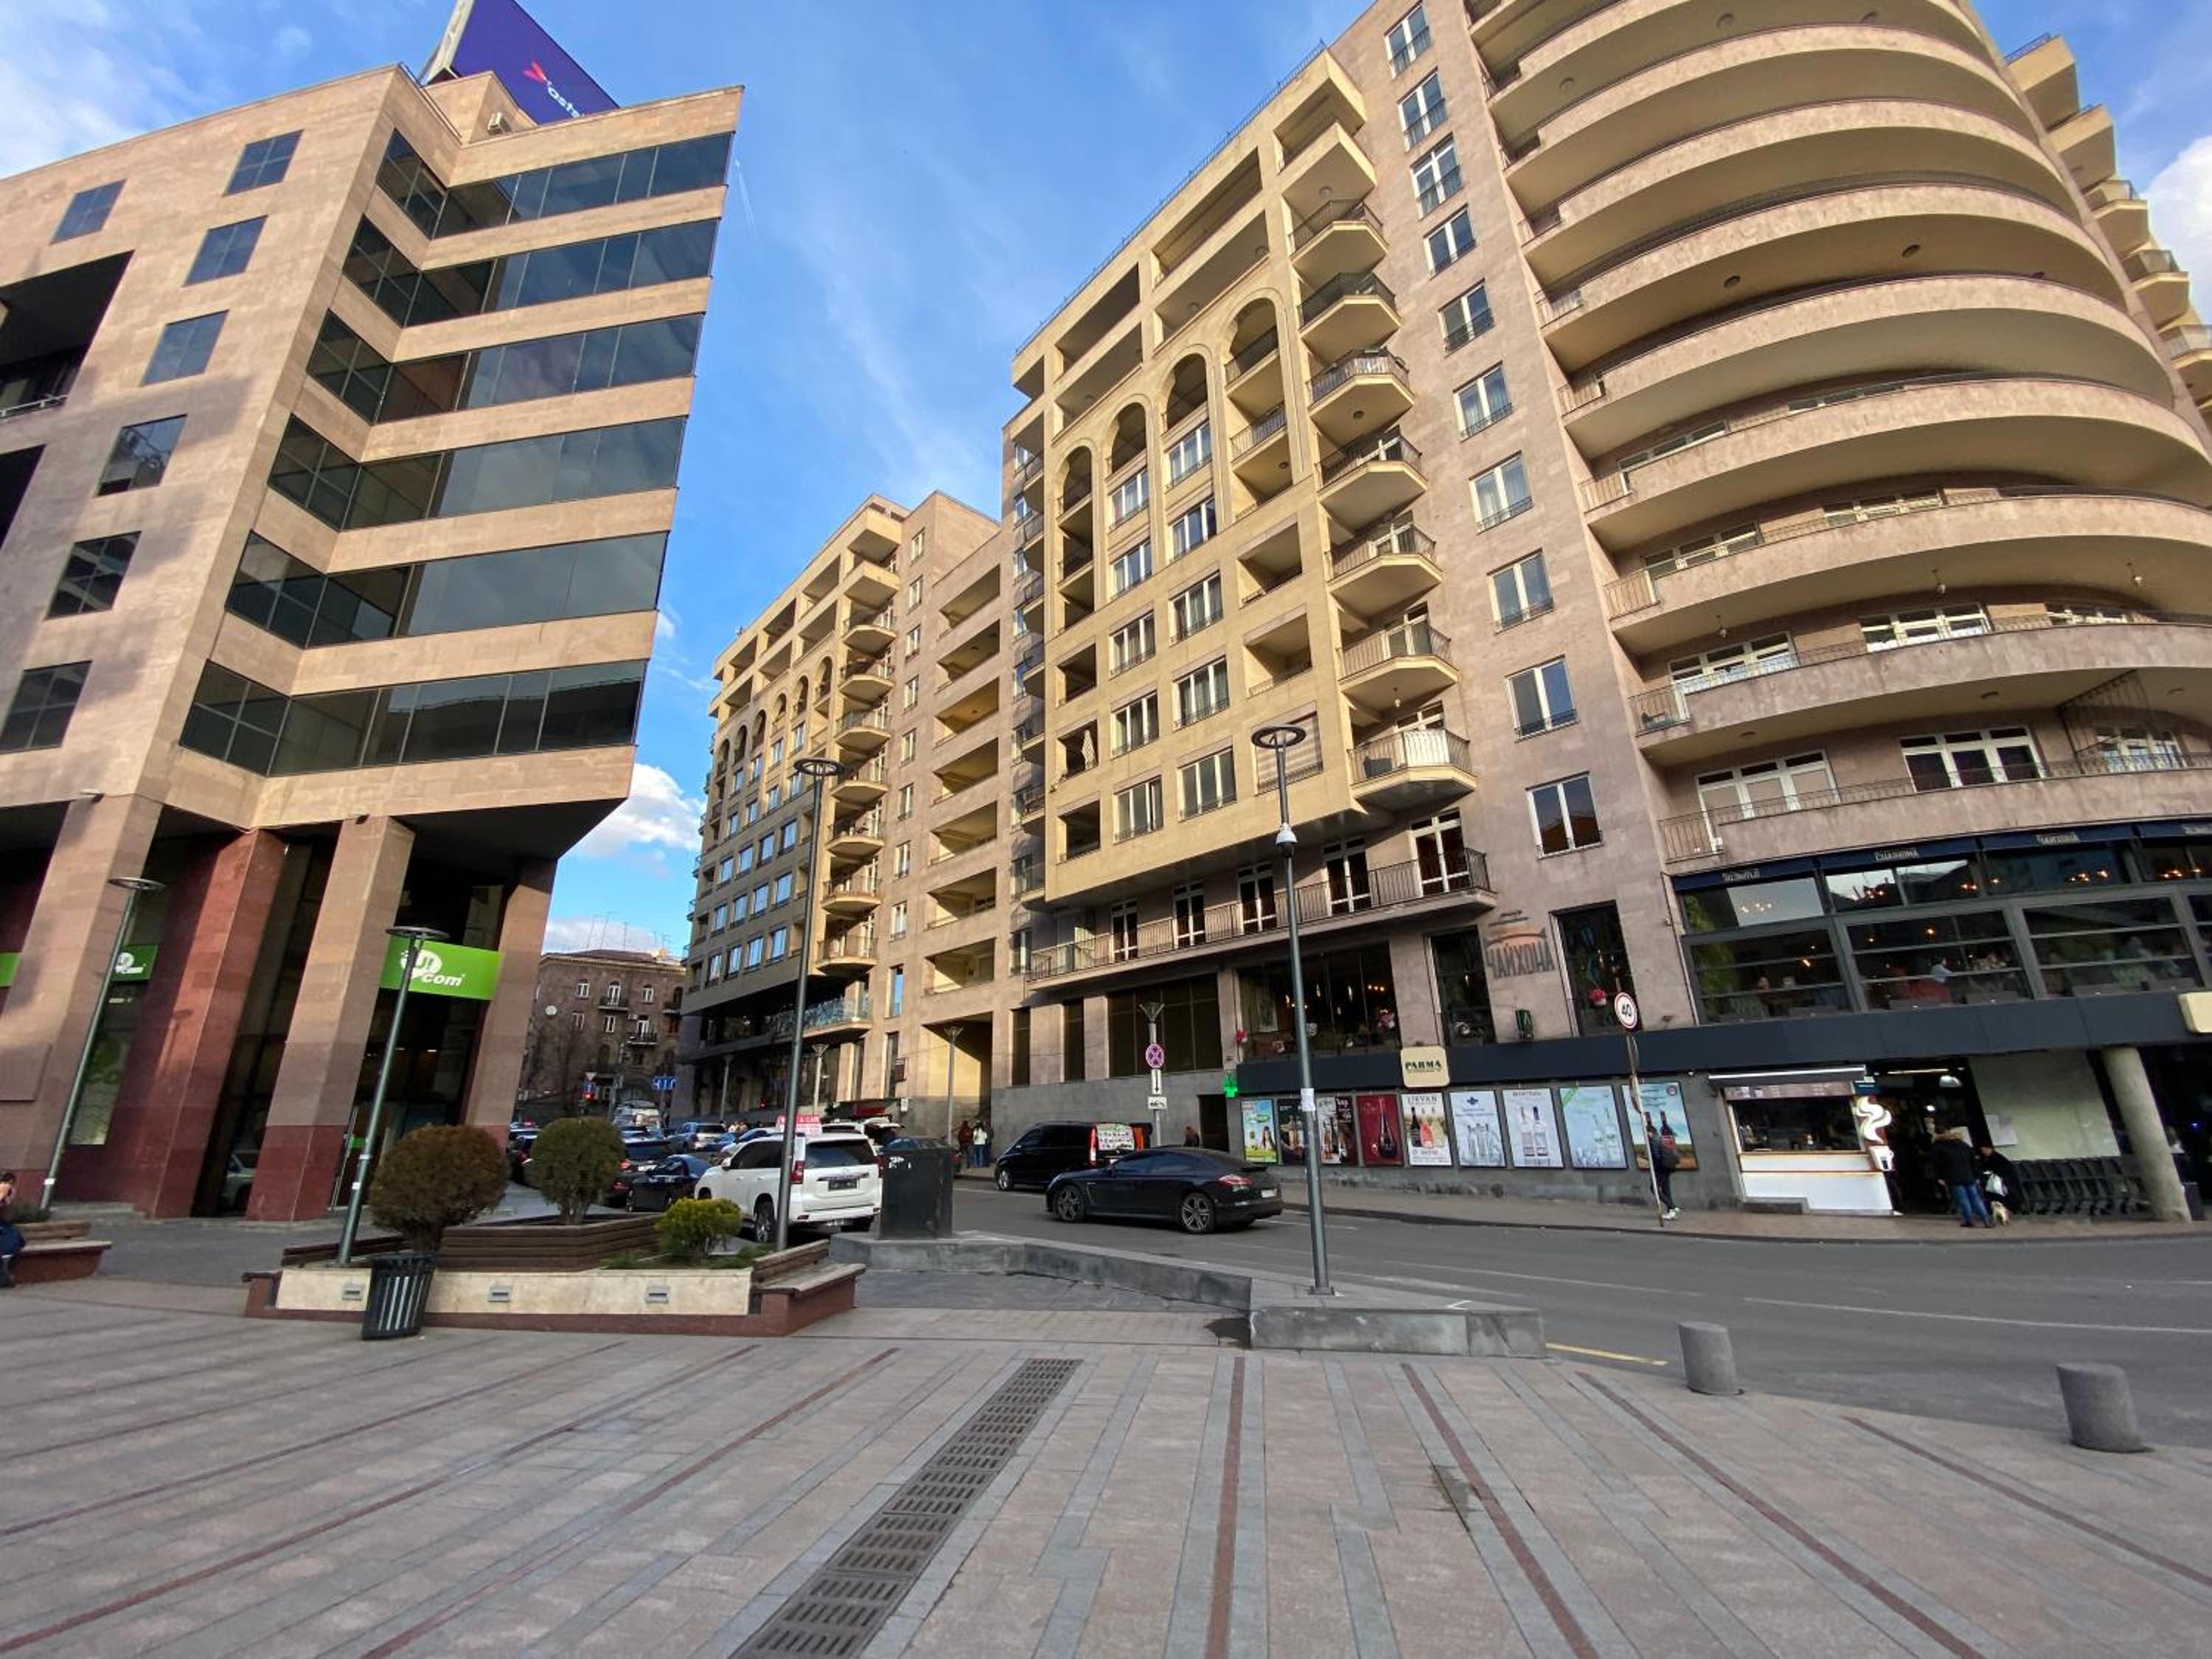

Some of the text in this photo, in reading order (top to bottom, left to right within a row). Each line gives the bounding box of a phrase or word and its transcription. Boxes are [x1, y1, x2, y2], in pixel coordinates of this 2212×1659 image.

[1486, 942, 1555, 979] ЧАЙХОНА
[1622, 1004, 1632, 1016] 40
[1405, 1060, 1441, 1069] PARMA
